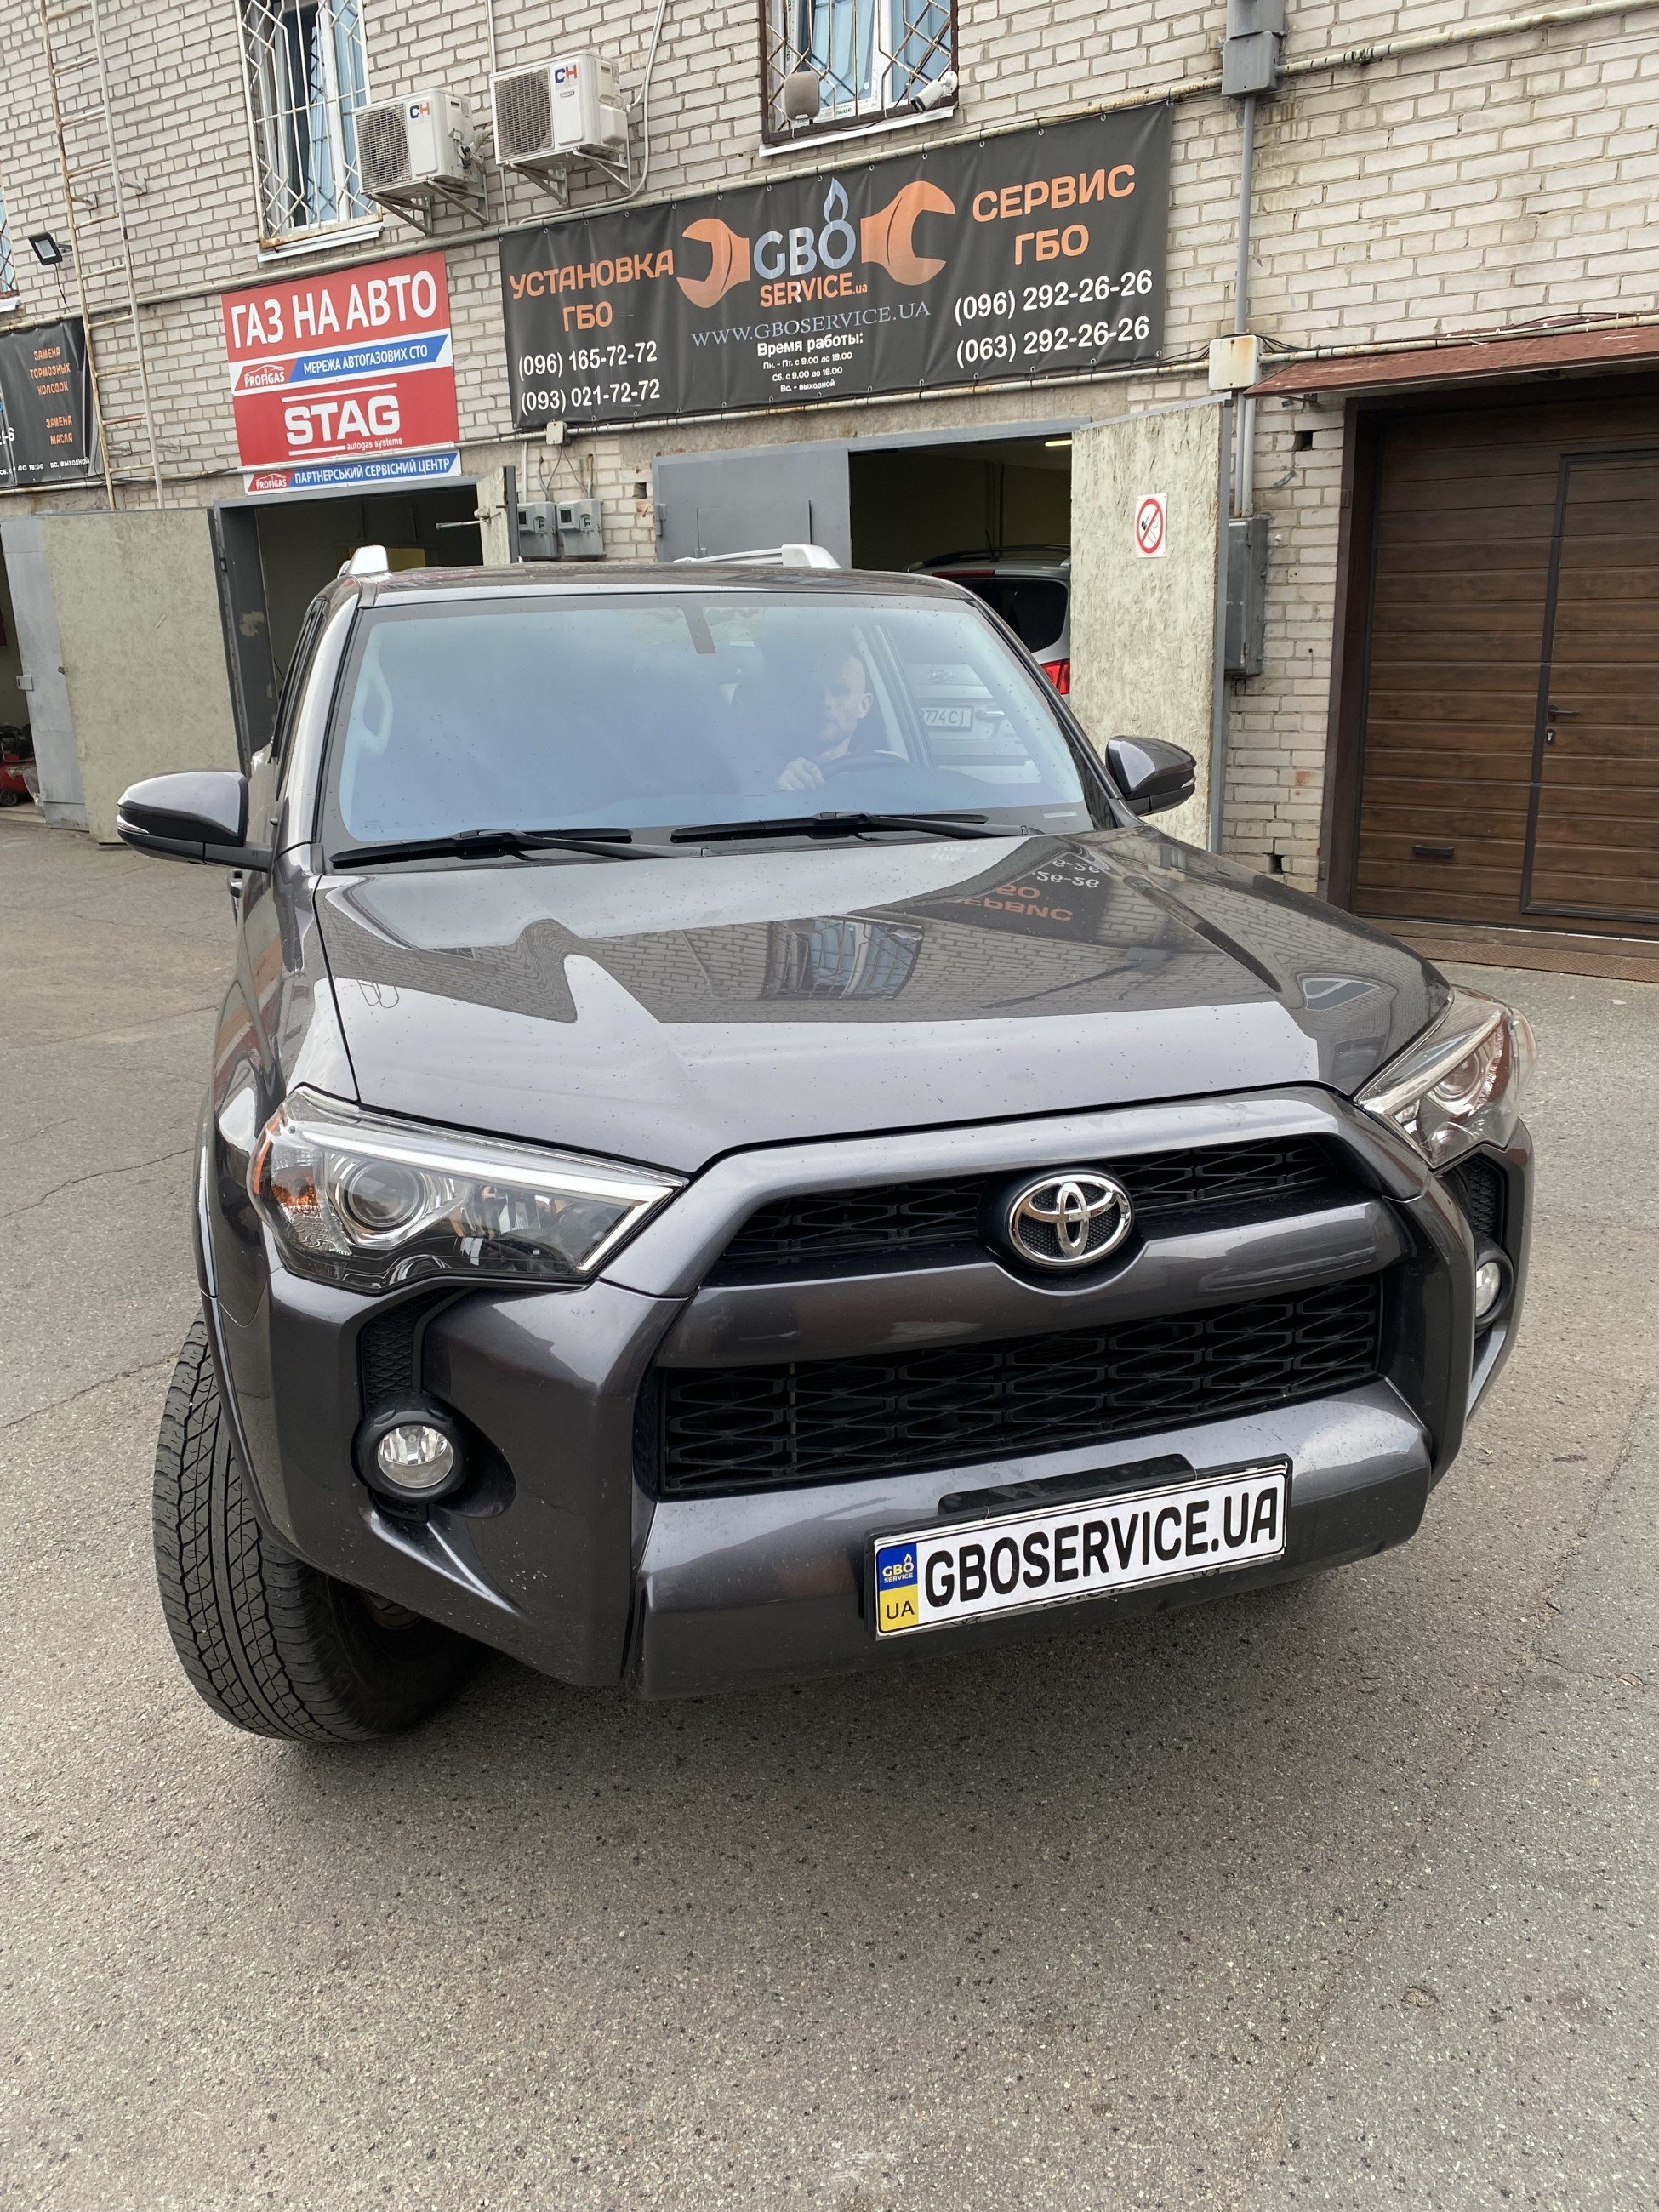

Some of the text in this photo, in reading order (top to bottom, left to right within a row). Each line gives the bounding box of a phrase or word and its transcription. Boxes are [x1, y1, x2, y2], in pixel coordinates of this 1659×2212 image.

[555, 64, 578, 83] CH
[409, 101, 430, 119] CH
[972, 163, 1136, 223] СЕРВИС
[754, 219, 857, 280] GBO
[1015, 224, 1089, 265] ГБО
[509, 249, 674, 299] УСТАНОВКА
[231, 271, 437, 349] ГАЗ НА АВТО
[955, 269, 1153, 327] (096) 292-26-26
[563, 300, 613, 332] ГБО
[691, 300, 932, 347] WWW.GBOSERVICE.UA
[33, 346, 61, 361] ЗАМЕНА
[757, 333, 864, 357] Время работы:
[956, 316, 1149, 369] (063) 292-26-26
[29, 362, 71, 379] ТОРМОЗНЫХ
[304, 345, 428, 375] МЕРЕЖА АВТОГАЗОВИХ СТО
[519, 340, 657, 381] (096) 165-72-72
[37, 381, 69, 395] КОЛОДОК
[522, 379, 660, 416] (093) 021-72-72
[799, 379, 835, 391] выходной
[45, 415, 73, 429] ЗАМЕНА
[284, 395, 400, 445] STAG
[49, 432, 73, 445] МАСЛА
[346, 437, 403, 452] autogas systems
[294, 458, 450, 484] ПАРТНЕРСЬКИЙ СЕРВІСНИЙ ЦЕНТР
[925, 1486, 1279, 1608] GBOSERVICE.UA
[882, 1561, 915, 1577] GBO
[884, 1572, 914, 1583] SERVICE
[886, 1600, 915, 1620] UA
